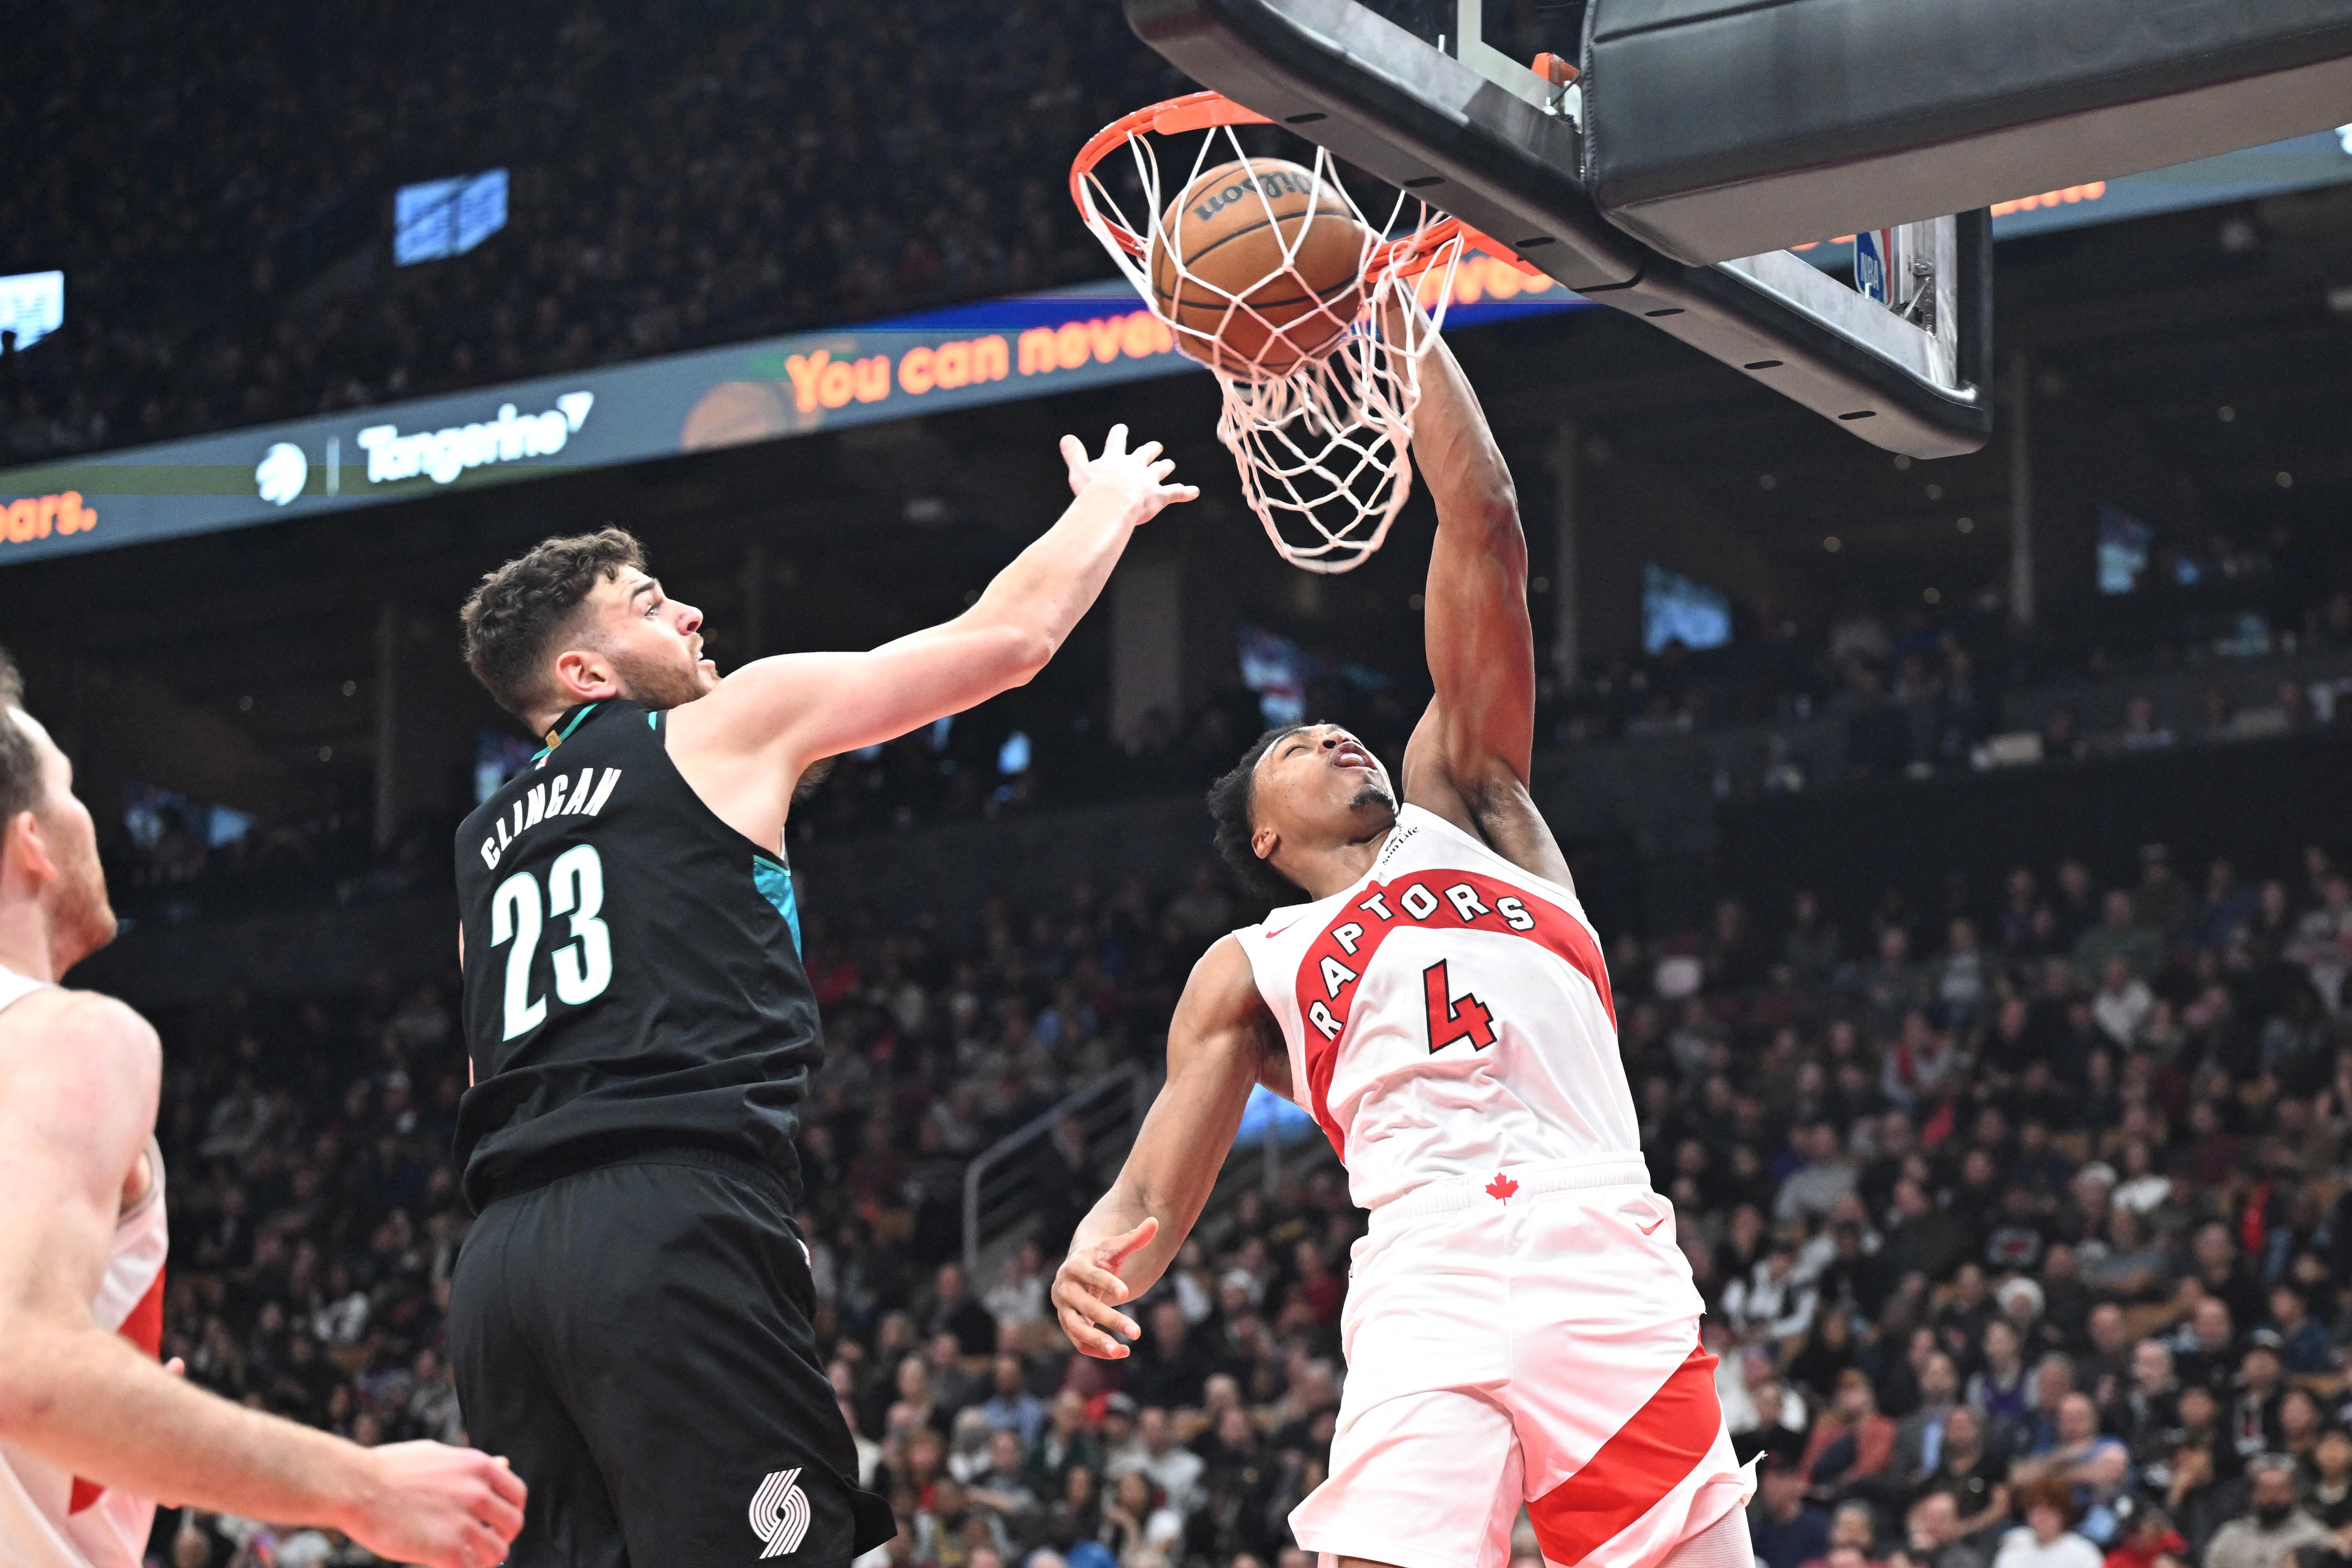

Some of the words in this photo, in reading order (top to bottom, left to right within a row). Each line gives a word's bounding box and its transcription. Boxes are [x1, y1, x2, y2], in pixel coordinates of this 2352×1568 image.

[1860, 252, 1880, 291] NBA
[785, 350, 891, 413] You
[898, 335, 1009, 394] can
[357, 403, 568, 483] Tangerine
[0, 490, 98, 543] ars.
[481, 768, 622, 870] CLINGAN
[1383, 845, 1399, 865] Sun
[1398, 827, 1420, 844] Life
[491, 844, 613, 1041] 23
[1308, 883, 1535, 1041] RAPTORS
[1422, 958, 1497, 1055] 4
